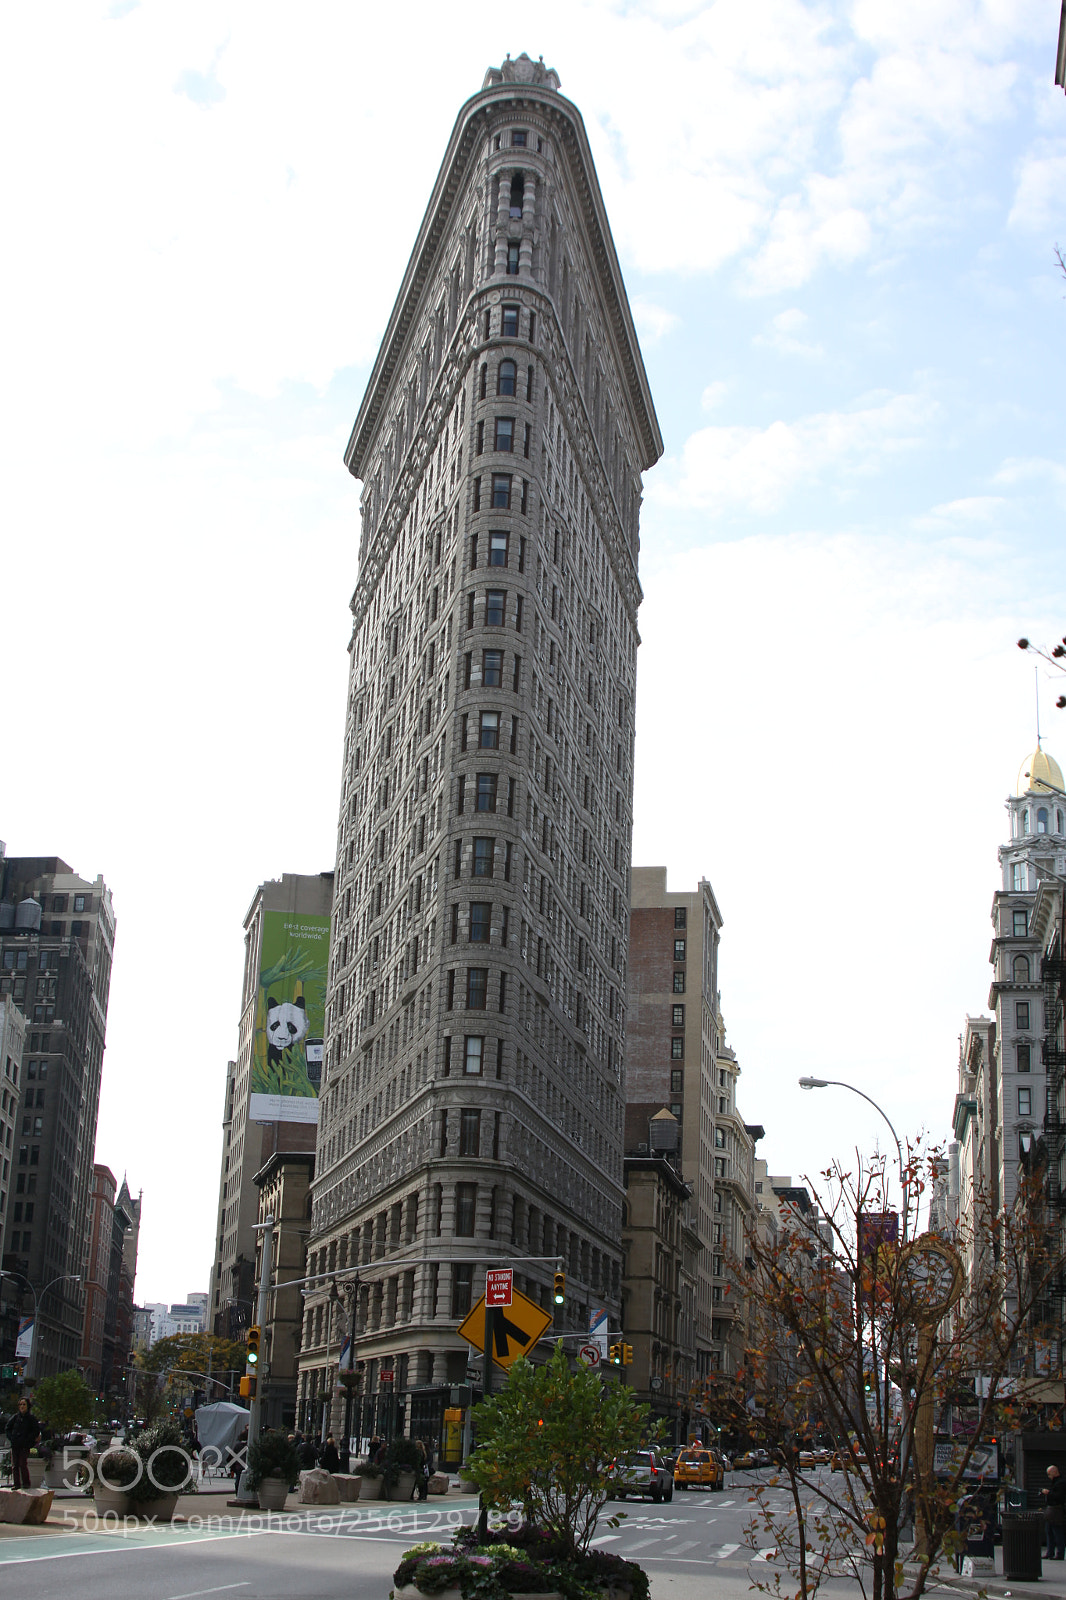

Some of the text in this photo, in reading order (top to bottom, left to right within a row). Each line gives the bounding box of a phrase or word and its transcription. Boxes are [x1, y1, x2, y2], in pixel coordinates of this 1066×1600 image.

[300, 925, 330, 935] coverage
[495, 1272, 511, 1281] STANDING
[490, 1282, 509, 1291] ANYTIME
